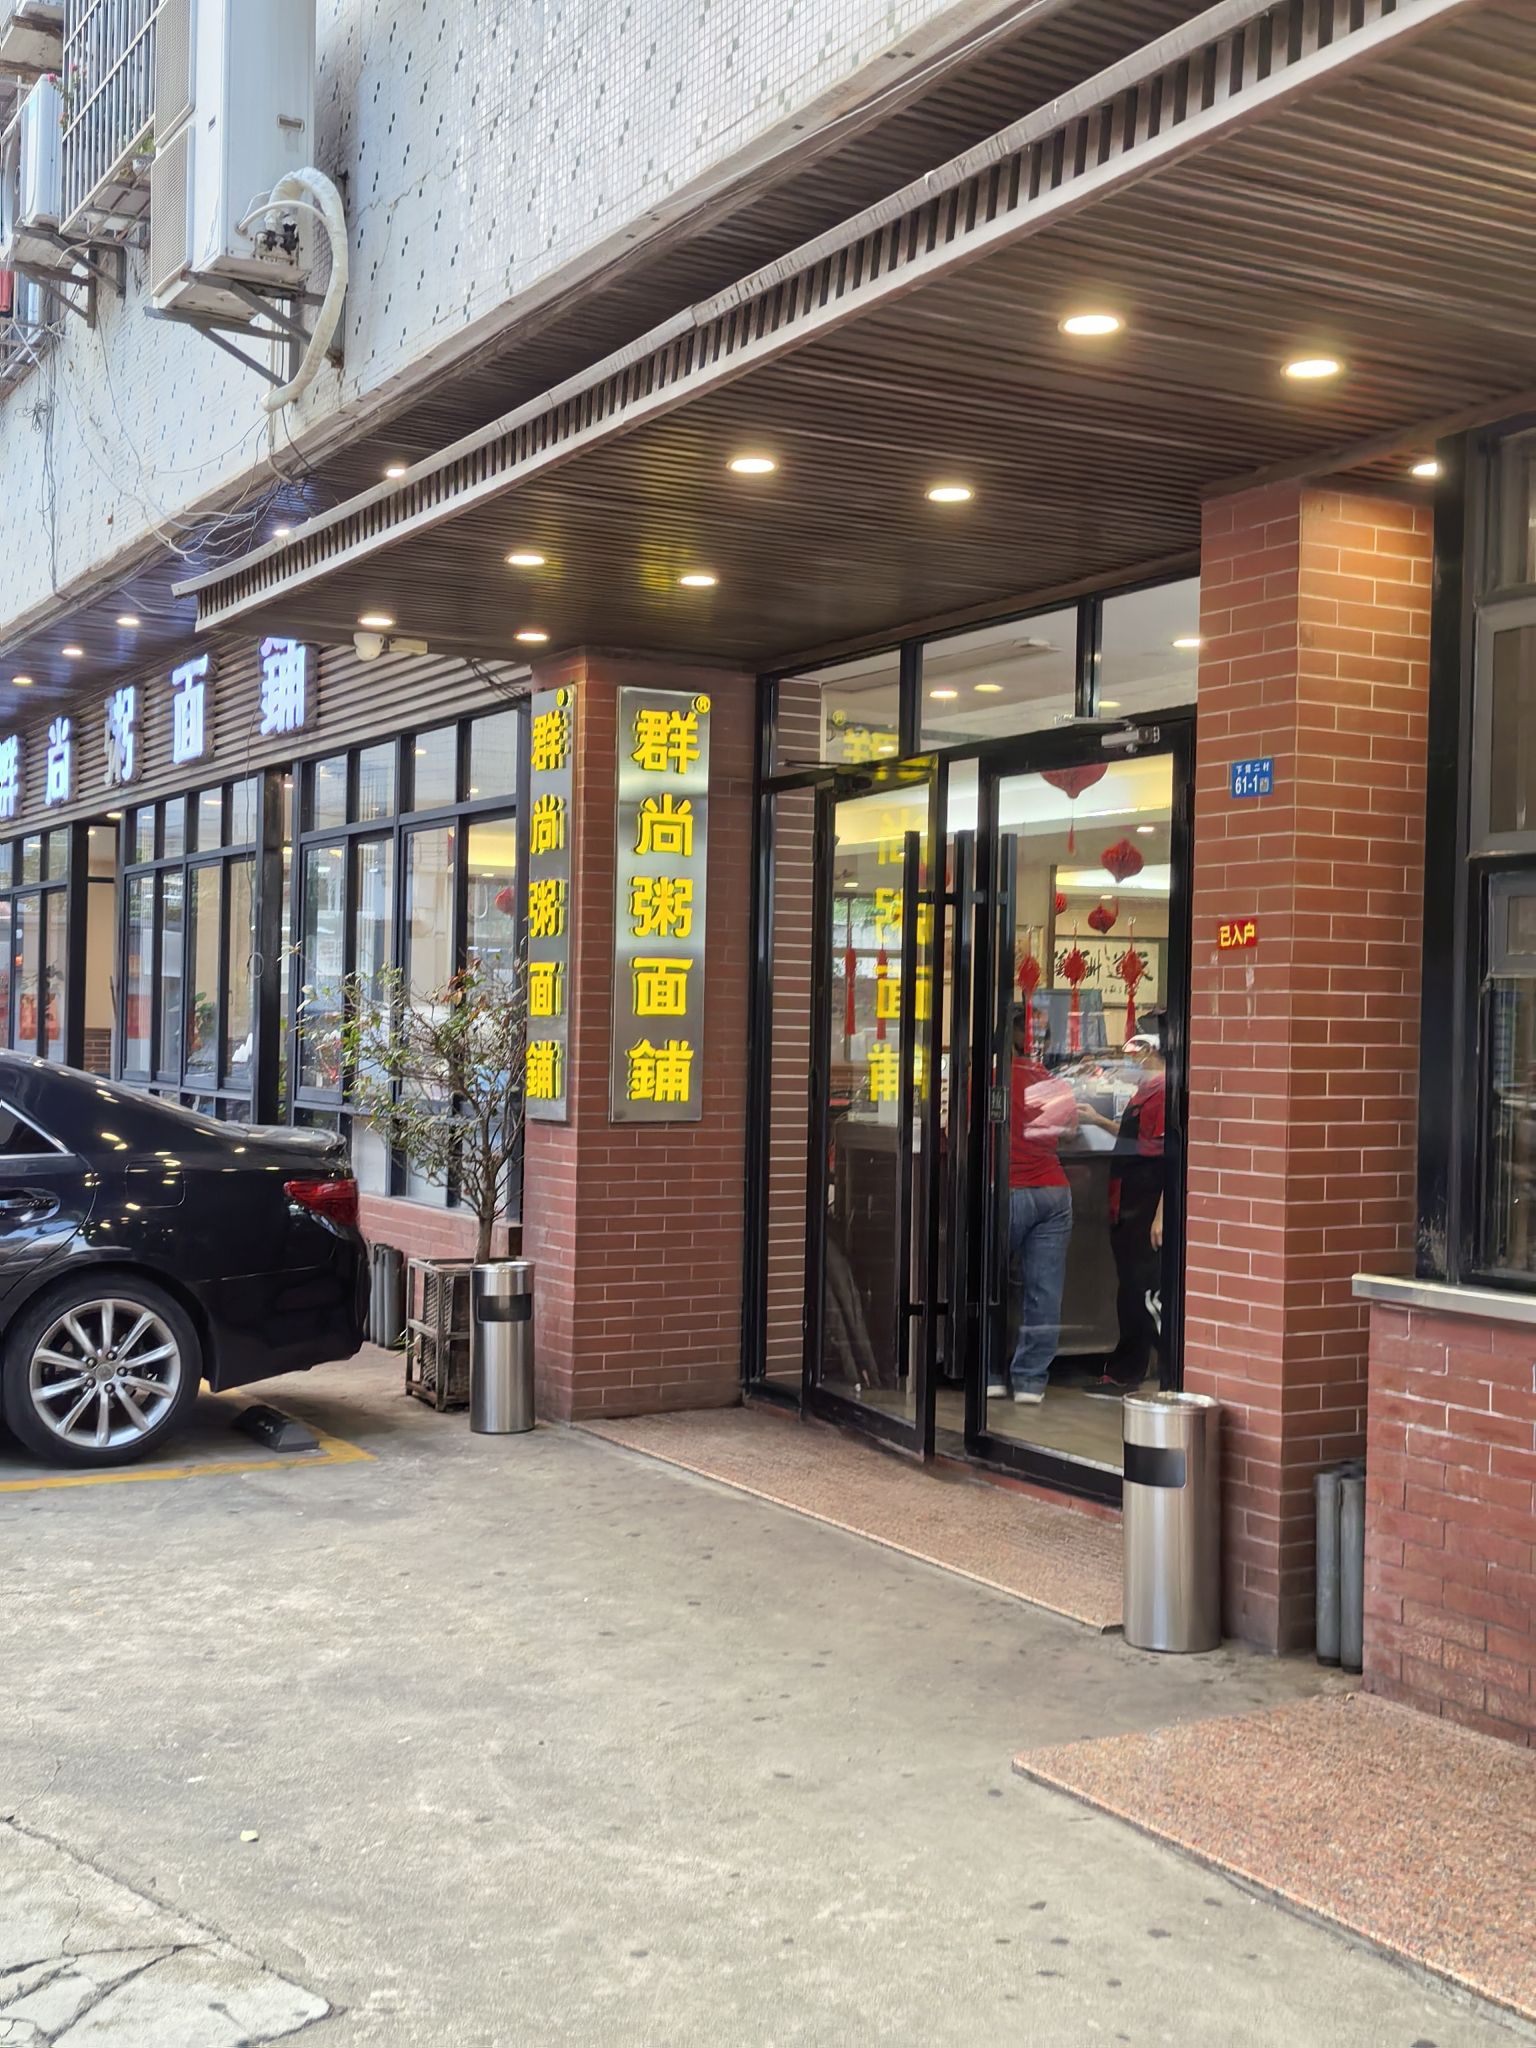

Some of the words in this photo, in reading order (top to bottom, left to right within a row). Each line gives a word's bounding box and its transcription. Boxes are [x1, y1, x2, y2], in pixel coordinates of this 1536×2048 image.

[526, 709, 565, 1099] 群尚粥面鋪
[628, 709, 700, 1102] 群尚粥面鋪
[1234, 774, 1259, 795] 61-1
